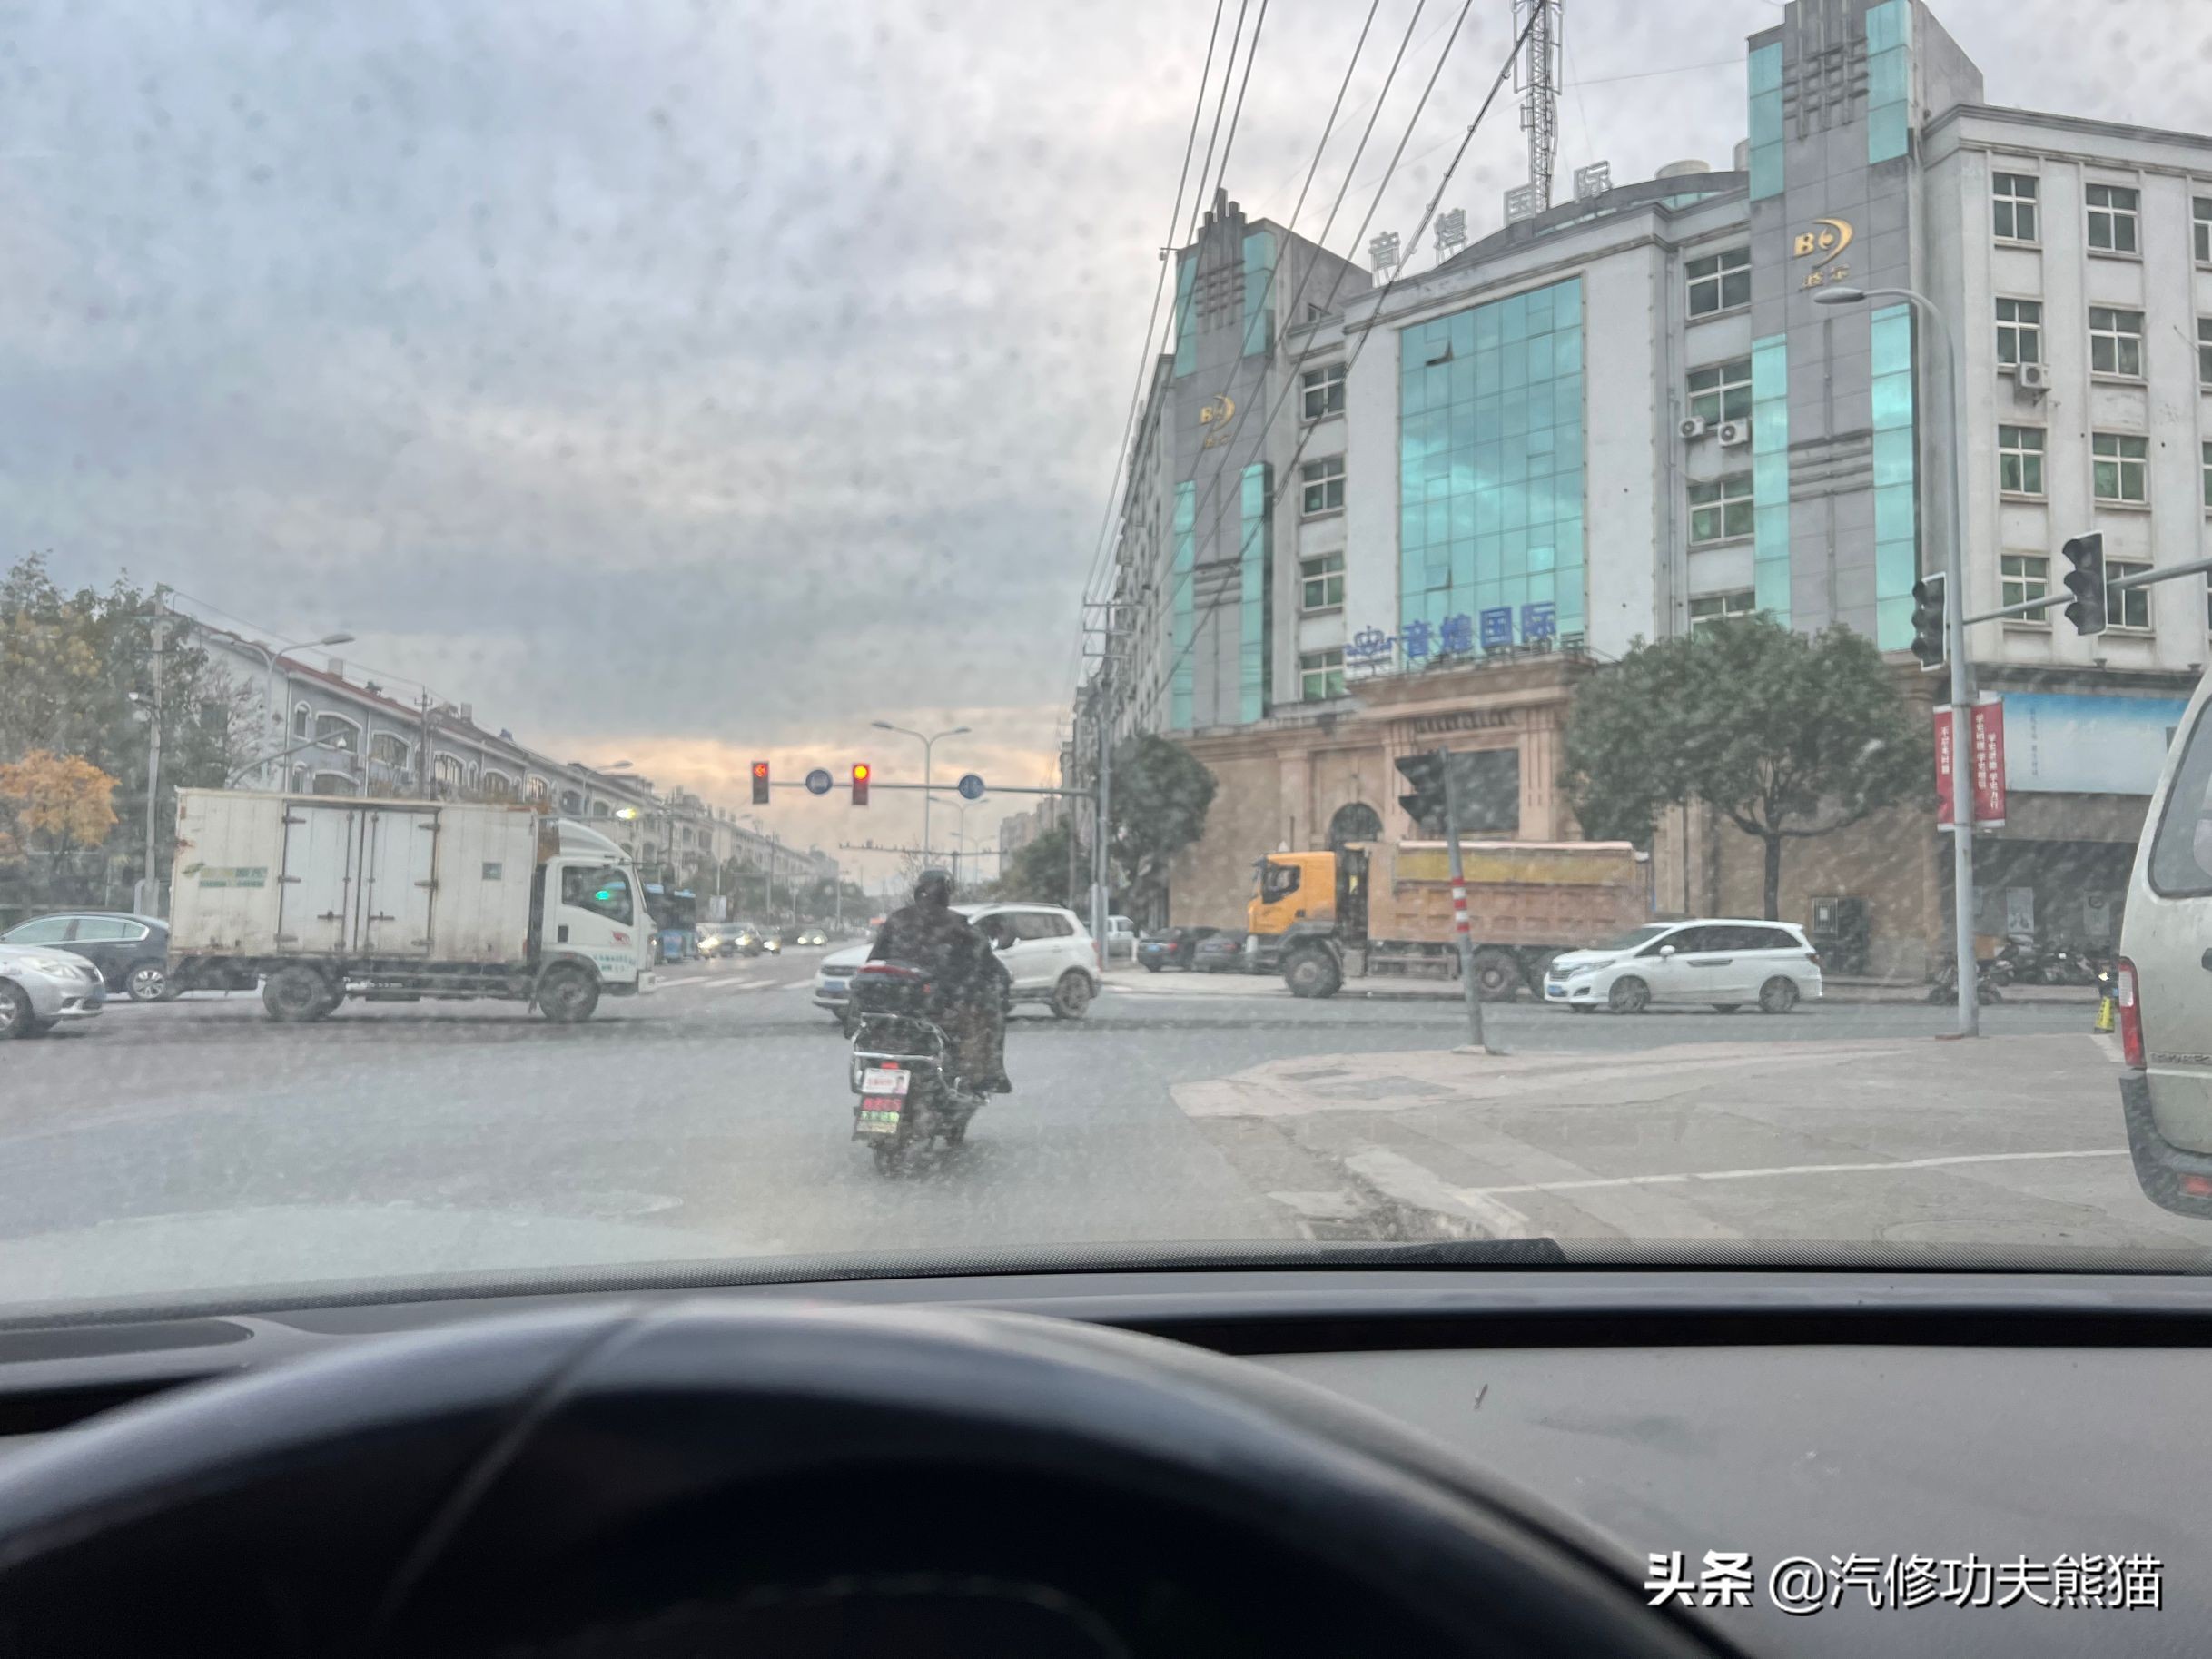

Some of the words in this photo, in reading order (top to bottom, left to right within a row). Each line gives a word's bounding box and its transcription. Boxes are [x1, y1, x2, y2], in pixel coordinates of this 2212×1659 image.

[1368, 160, 1614, 271] 音煌国际
[1403, 601, 1556, 658] 音煌国际
